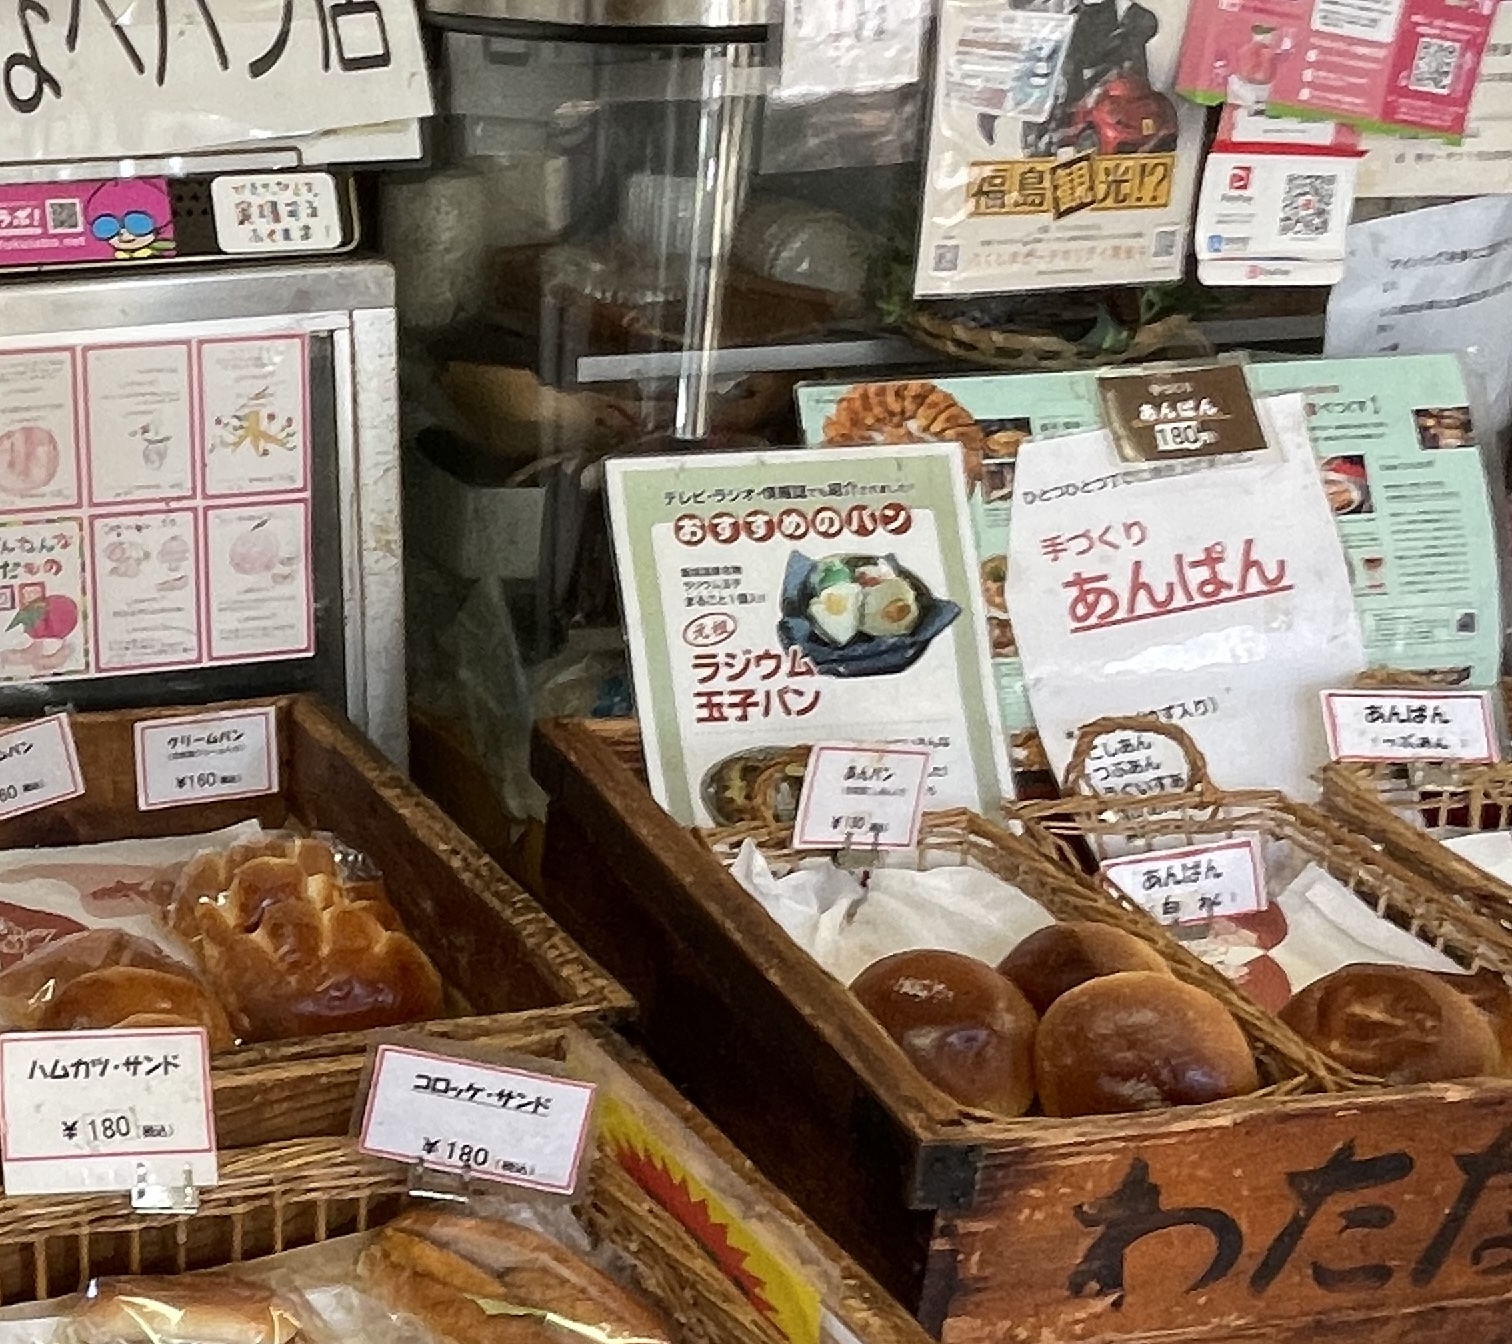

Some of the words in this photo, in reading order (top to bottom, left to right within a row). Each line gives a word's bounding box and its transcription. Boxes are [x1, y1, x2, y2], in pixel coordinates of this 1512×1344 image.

[675, 503, 912, 547] おすすめのパン
[1040, 520, 1148, 563] 手づくり
[1062, 538, 1287, 624] あんぱん
[691, 649, 816, 684] ラジウム
[692, 686, 821, 724] 玉子パン
[1363, 704, 1451, 725] あんぱん
[166, 729, 245, 750] クリームパン
[1142, 859, 1225, 889] あんぱん
[27, 1053, 181, 1081] ハムカツ・サンド
[412, 1073, 554, 1115] コロッケ・サンド
[60, 1114, 131, 1143] ¥180
[422, 1135, 490, 1168] ¥180
